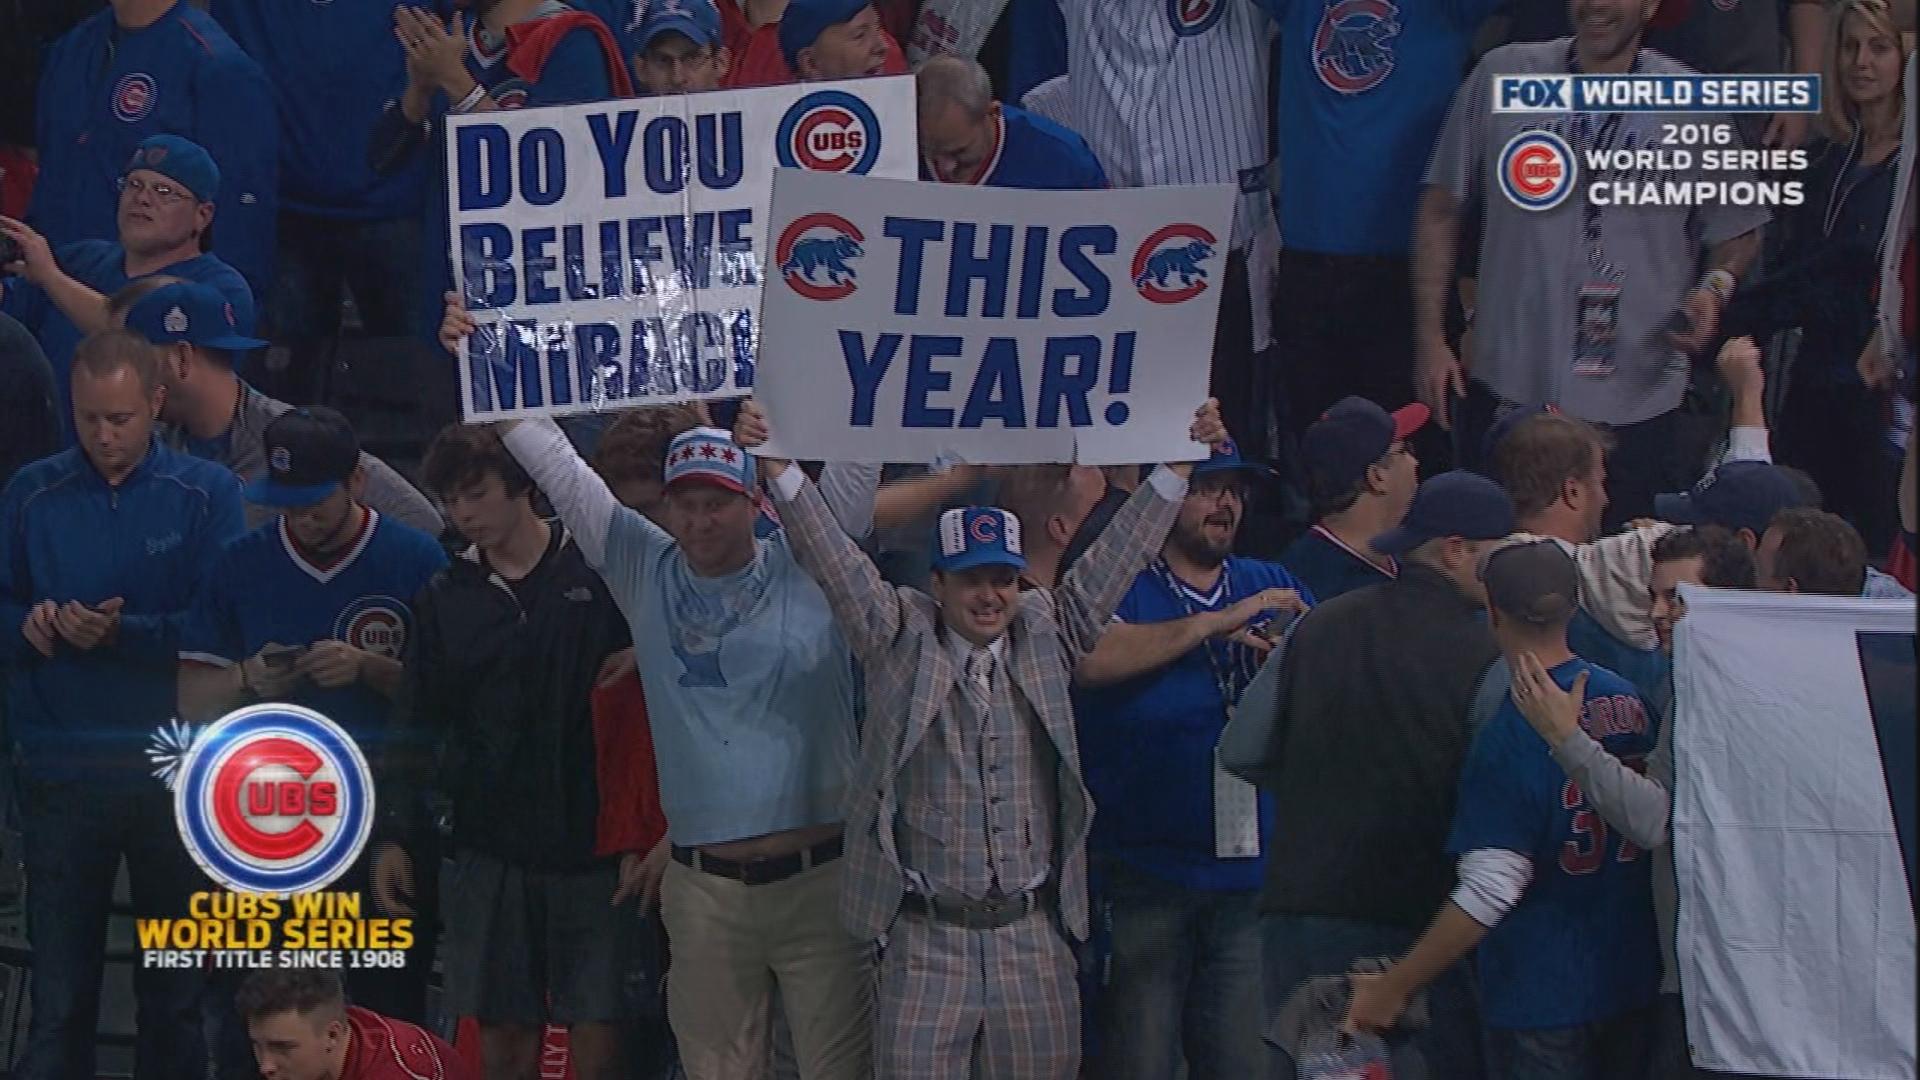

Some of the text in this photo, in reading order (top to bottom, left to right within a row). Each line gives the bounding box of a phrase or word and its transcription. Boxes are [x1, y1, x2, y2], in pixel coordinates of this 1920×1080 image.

[586, 109, 744, 199] YOU
[794, 108, 862, 173] CUBS
[460, 208, 758, 310] BELIEVE
[883, 216, 1118, 319] THIS
[837, 328, 1137, 428] YEAR!
